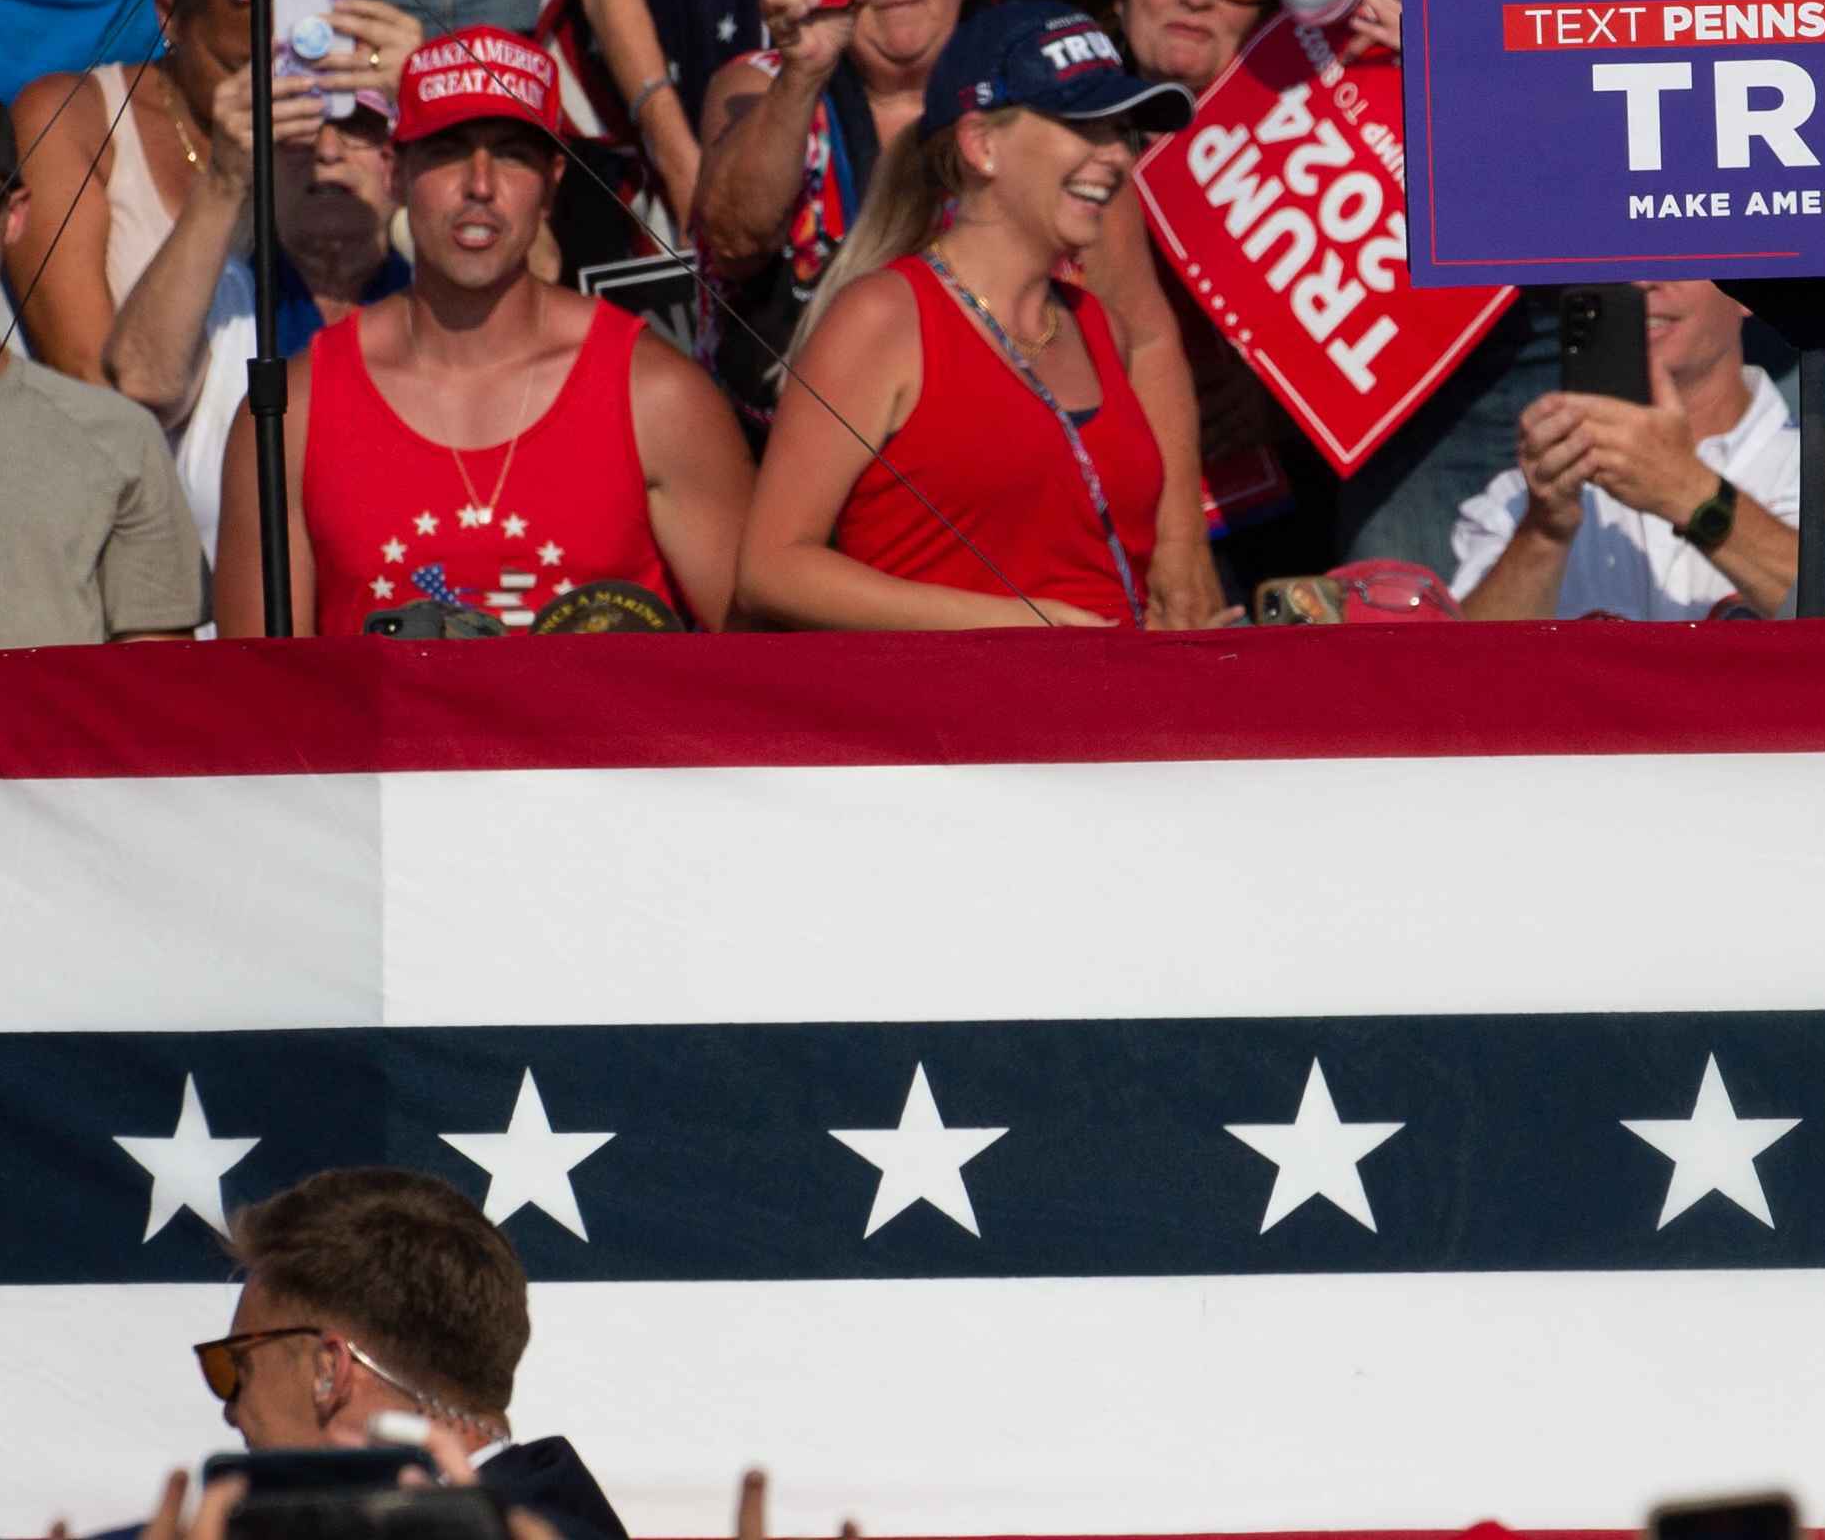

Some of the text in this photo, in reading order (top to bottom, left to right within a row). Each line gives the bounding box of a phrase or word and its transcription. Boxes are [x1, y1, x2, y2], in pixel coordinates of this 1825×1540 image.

[1525, 8, 1646, 46] TEXT
[409, 36, 552, 89] MAKE AMERICA
[418, 71, 545, 110] GREAT AGAIN
[1255, 82, 1406, 292] 2024
[1629, 192, 1731, 219] MAKE
[1186, 120, 1399, 394] TRUMP
